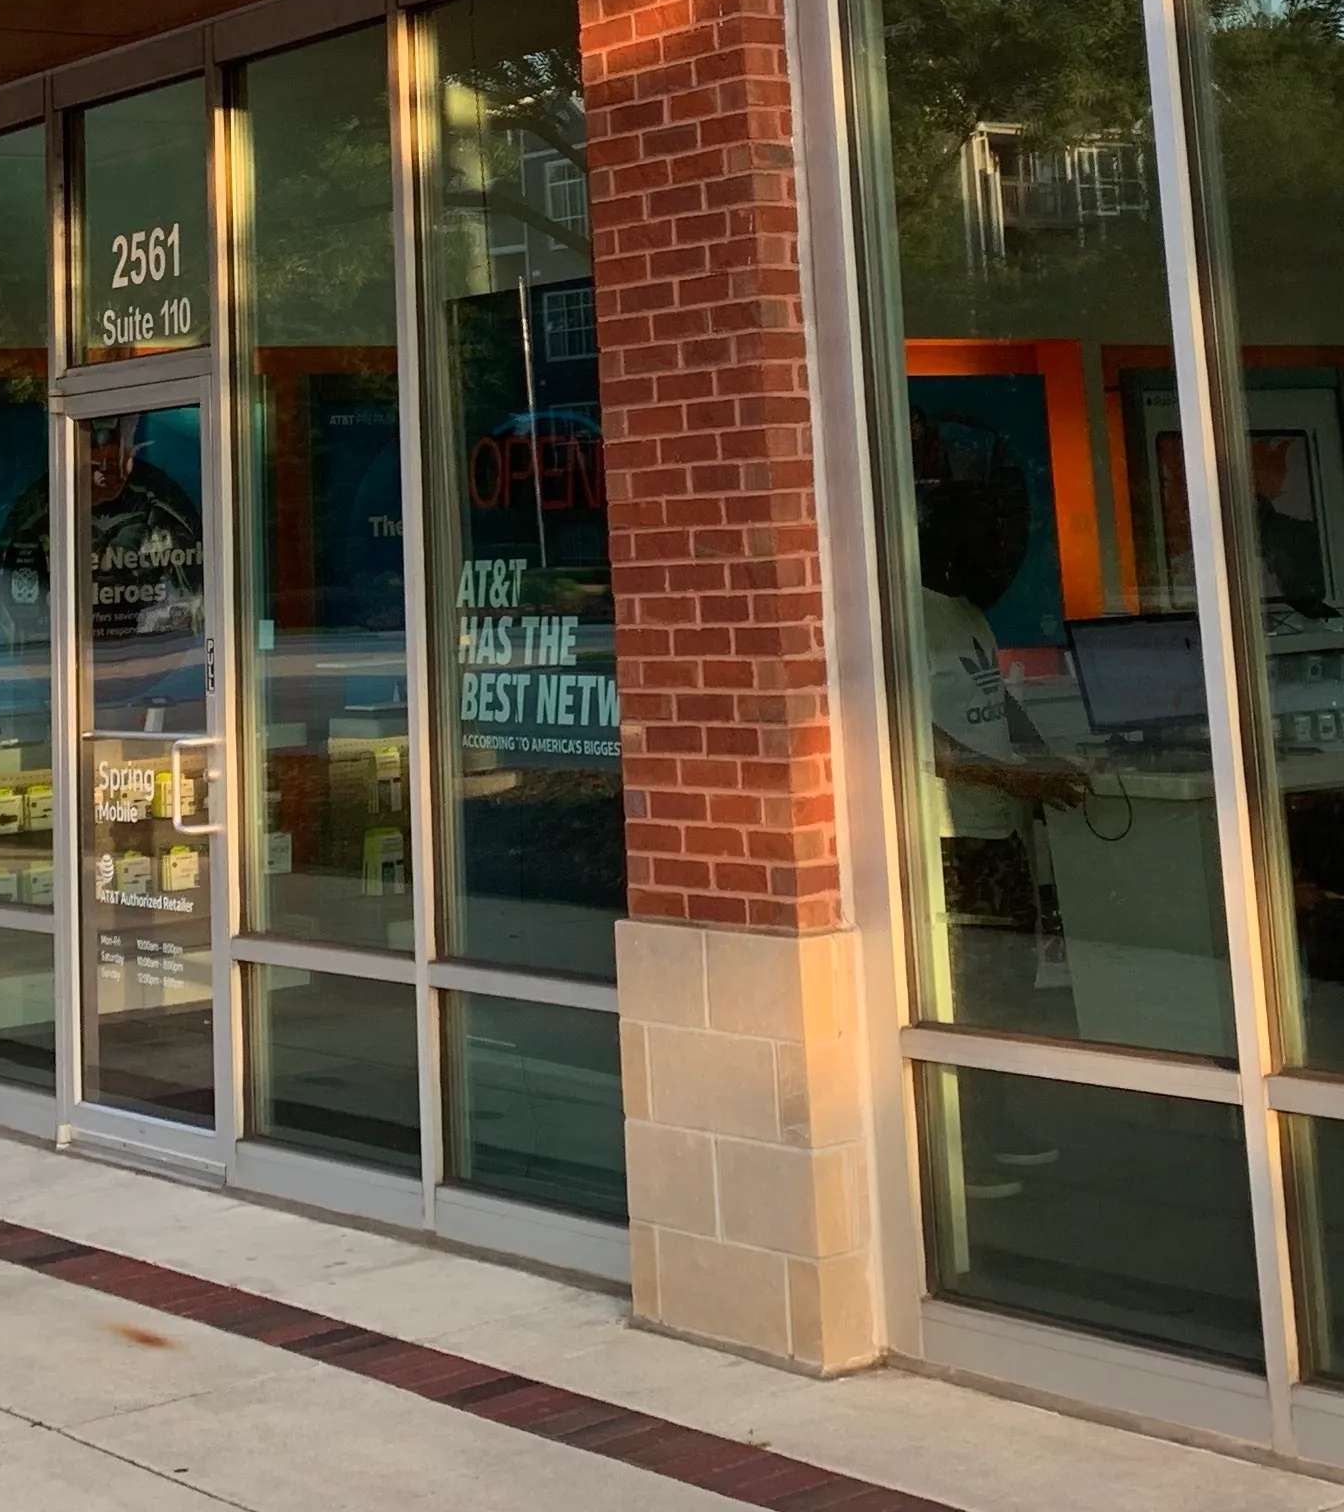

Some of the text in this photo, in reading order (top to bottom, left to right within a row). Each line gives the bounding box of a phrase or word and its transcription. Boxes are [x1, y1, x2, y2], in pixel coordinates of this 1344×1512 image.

[111, 223, 180, 288] 2561
[103, 297, 191, 346] Suite 110
[468, 437, 605, 509] OPEN
[456, 558, 528, 608] AT&T
[207, 639, 215, 691] PULL
[458, 616, 579, 666] HAS THE
[460, 673, 531, 723] BEST
[462, 734, 515, 750] ACCORDING
[531, 738, 582, 754] AMERICA'S
[99, 760, 155, 801] Spring
[99, 800, 138, 823] Mobile
[100, 890, 194, 913] AT&T Authorized Retailer
